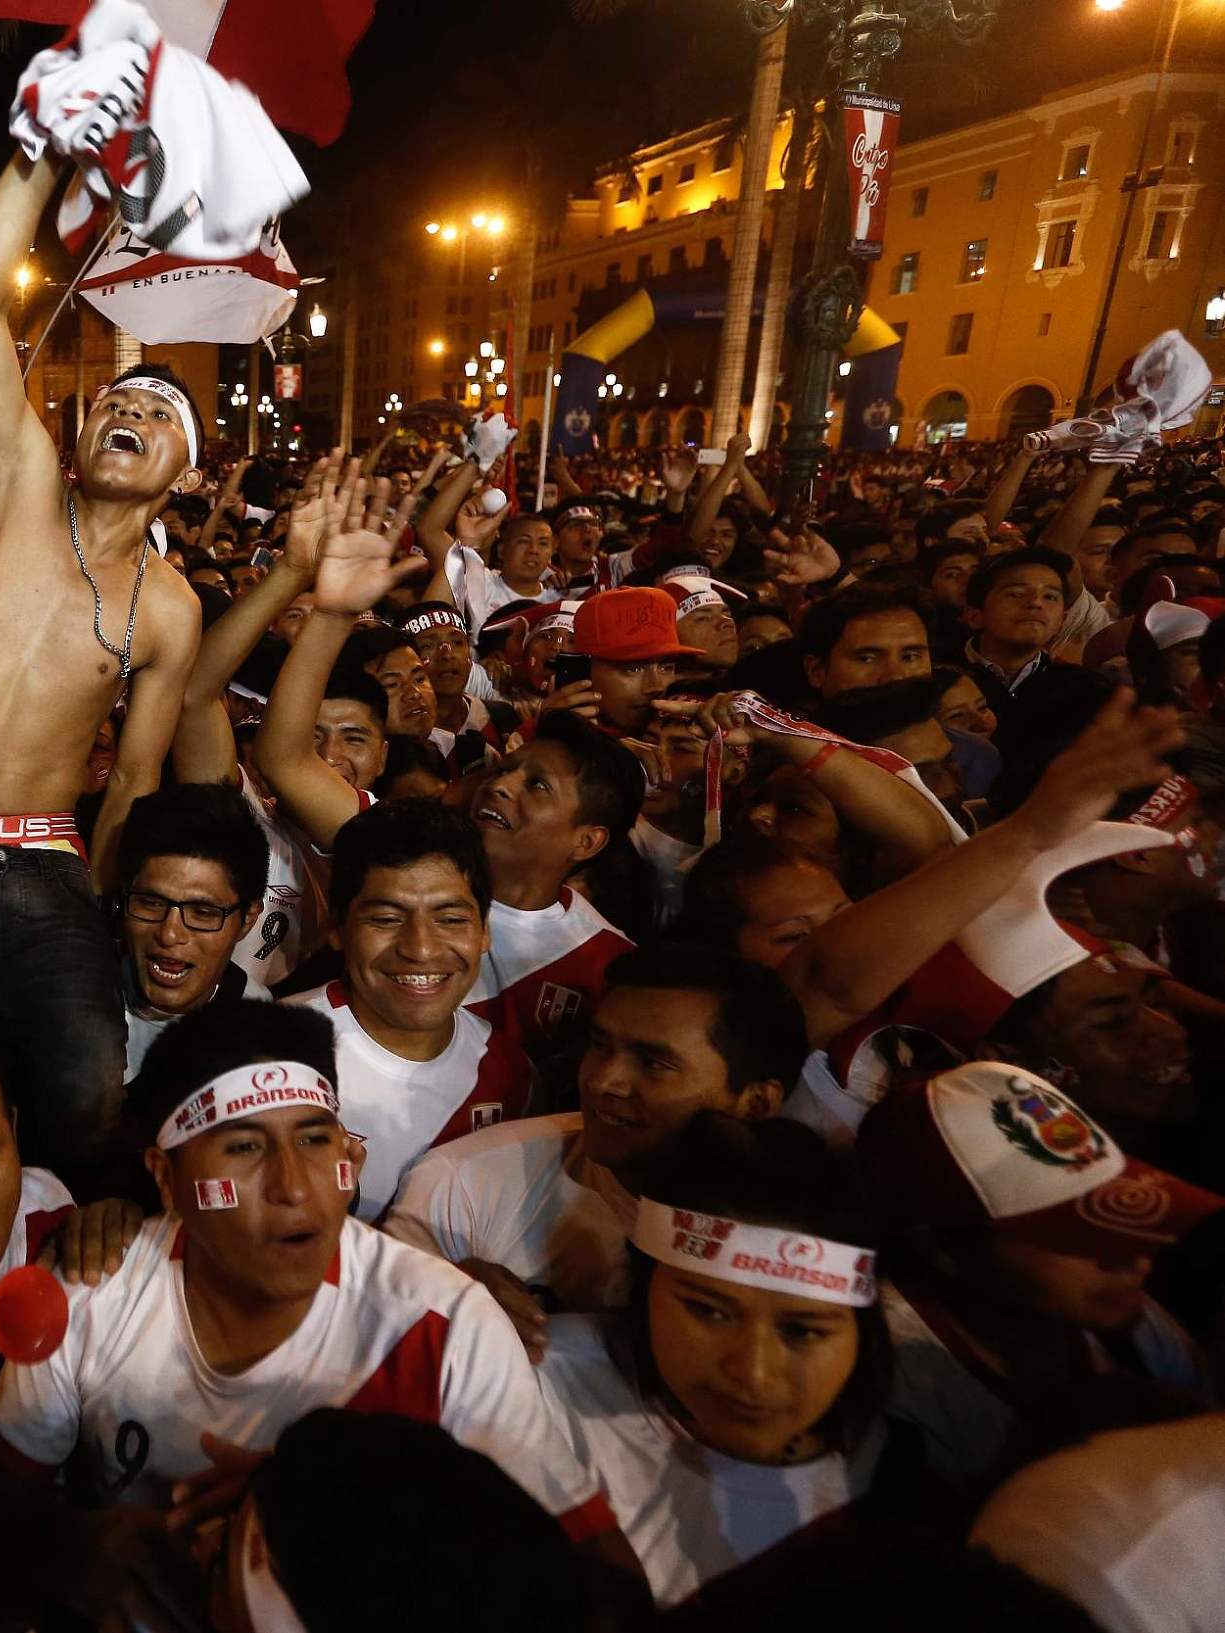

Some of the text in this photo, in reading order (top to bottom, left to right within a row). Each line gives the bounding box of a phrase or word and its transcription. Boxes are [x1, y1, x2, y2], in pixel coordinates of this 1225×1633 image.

[132, 279, 152, 289] EN
[268, 896, 296, 909] umbro
[254, 911, 289, 960] 9
[112, 1420, 150, 1491] 9
